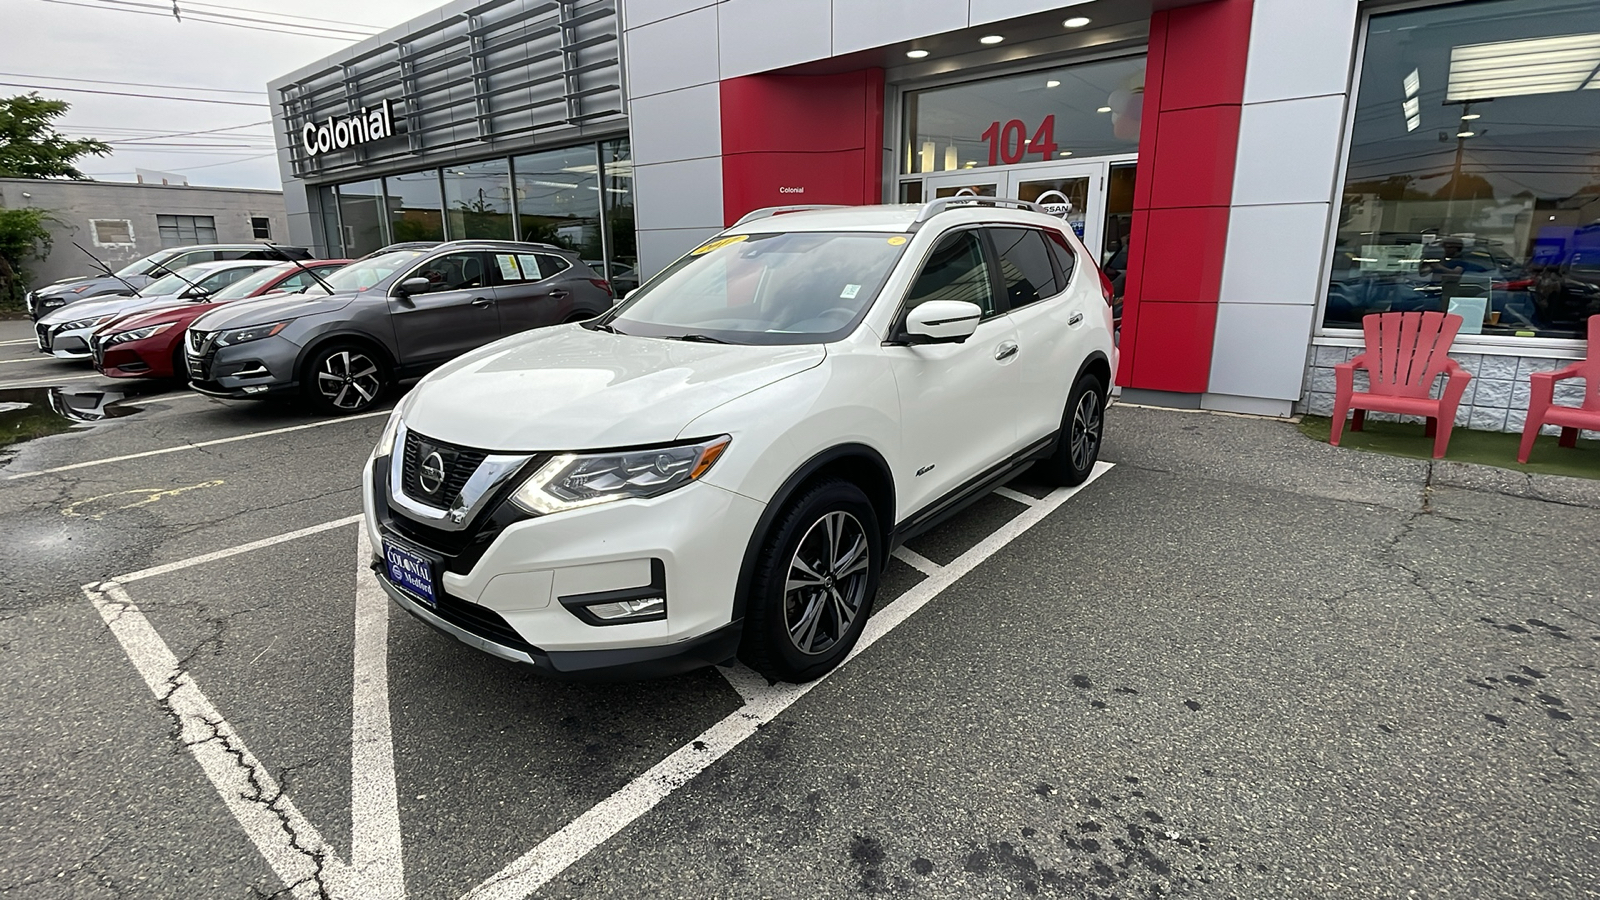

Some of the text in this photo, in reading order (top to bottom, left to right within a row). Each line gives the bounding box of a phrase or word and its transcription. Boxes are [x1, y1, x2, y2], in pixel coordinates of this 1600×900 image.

[303, 98, 391, 156] Colonial
[981, 114, 1058, 166] 104
[779, 186, 804, 194] Colonial
[1044, 205, 1069, 213] SSAN
[387, 545, 432, 583] COLONIAL
[404, 571, 432, 595] Medford
